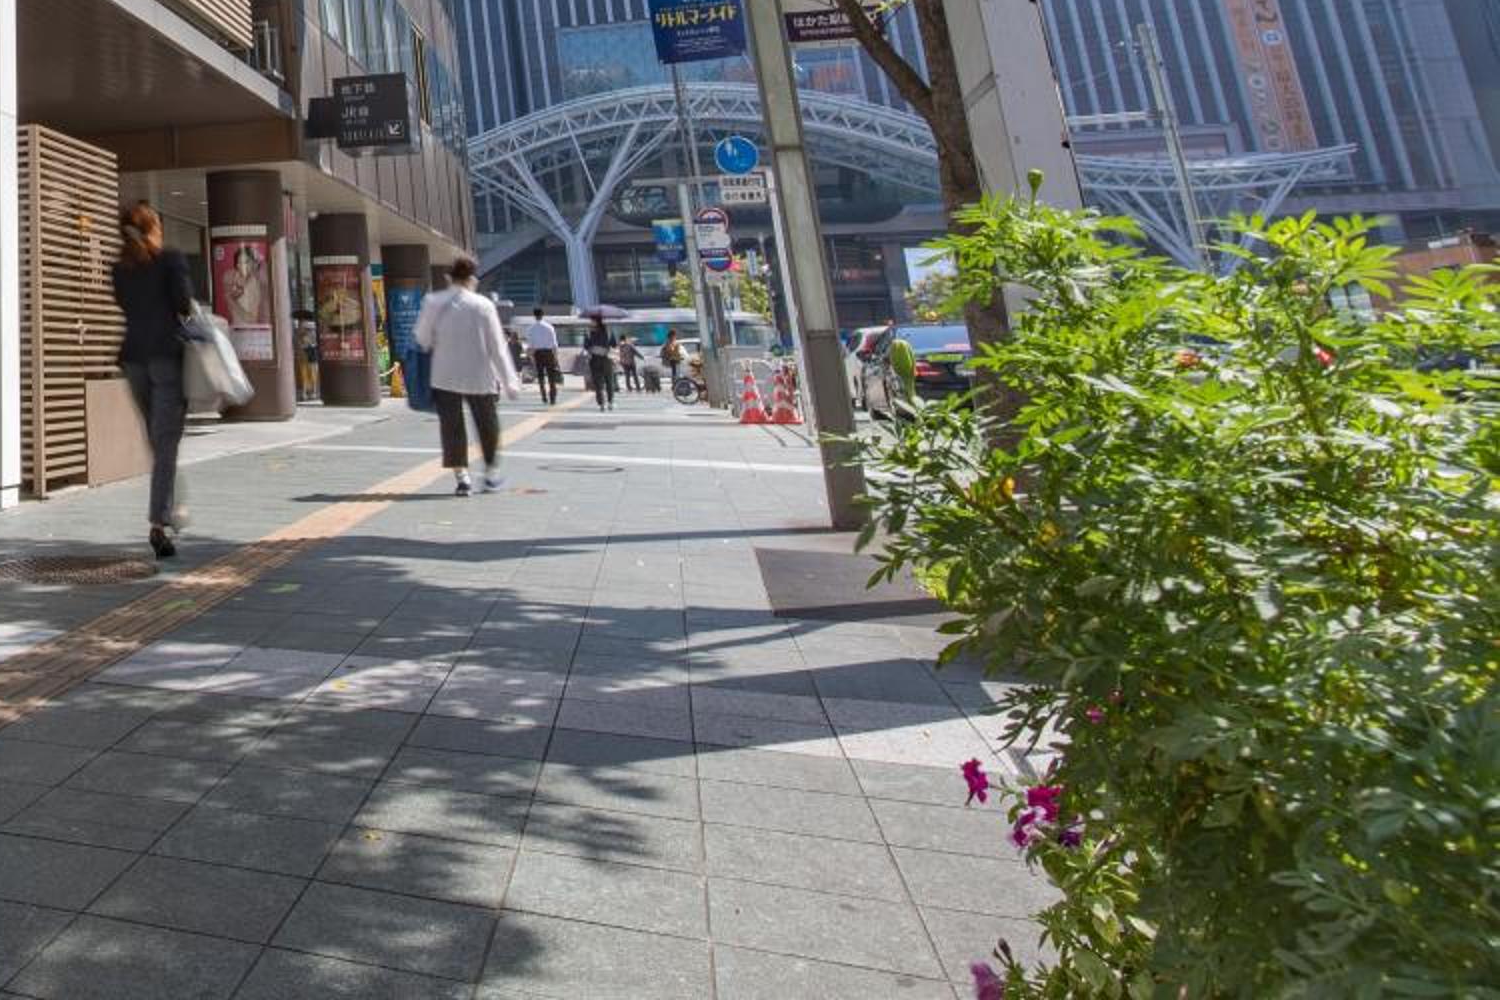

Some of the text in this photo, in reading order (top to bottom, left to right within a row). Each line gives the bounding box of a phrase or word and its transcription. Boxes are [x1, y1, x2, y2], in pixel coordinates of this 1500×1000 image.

[655, 4, 738, 28] リトルマーメイド
